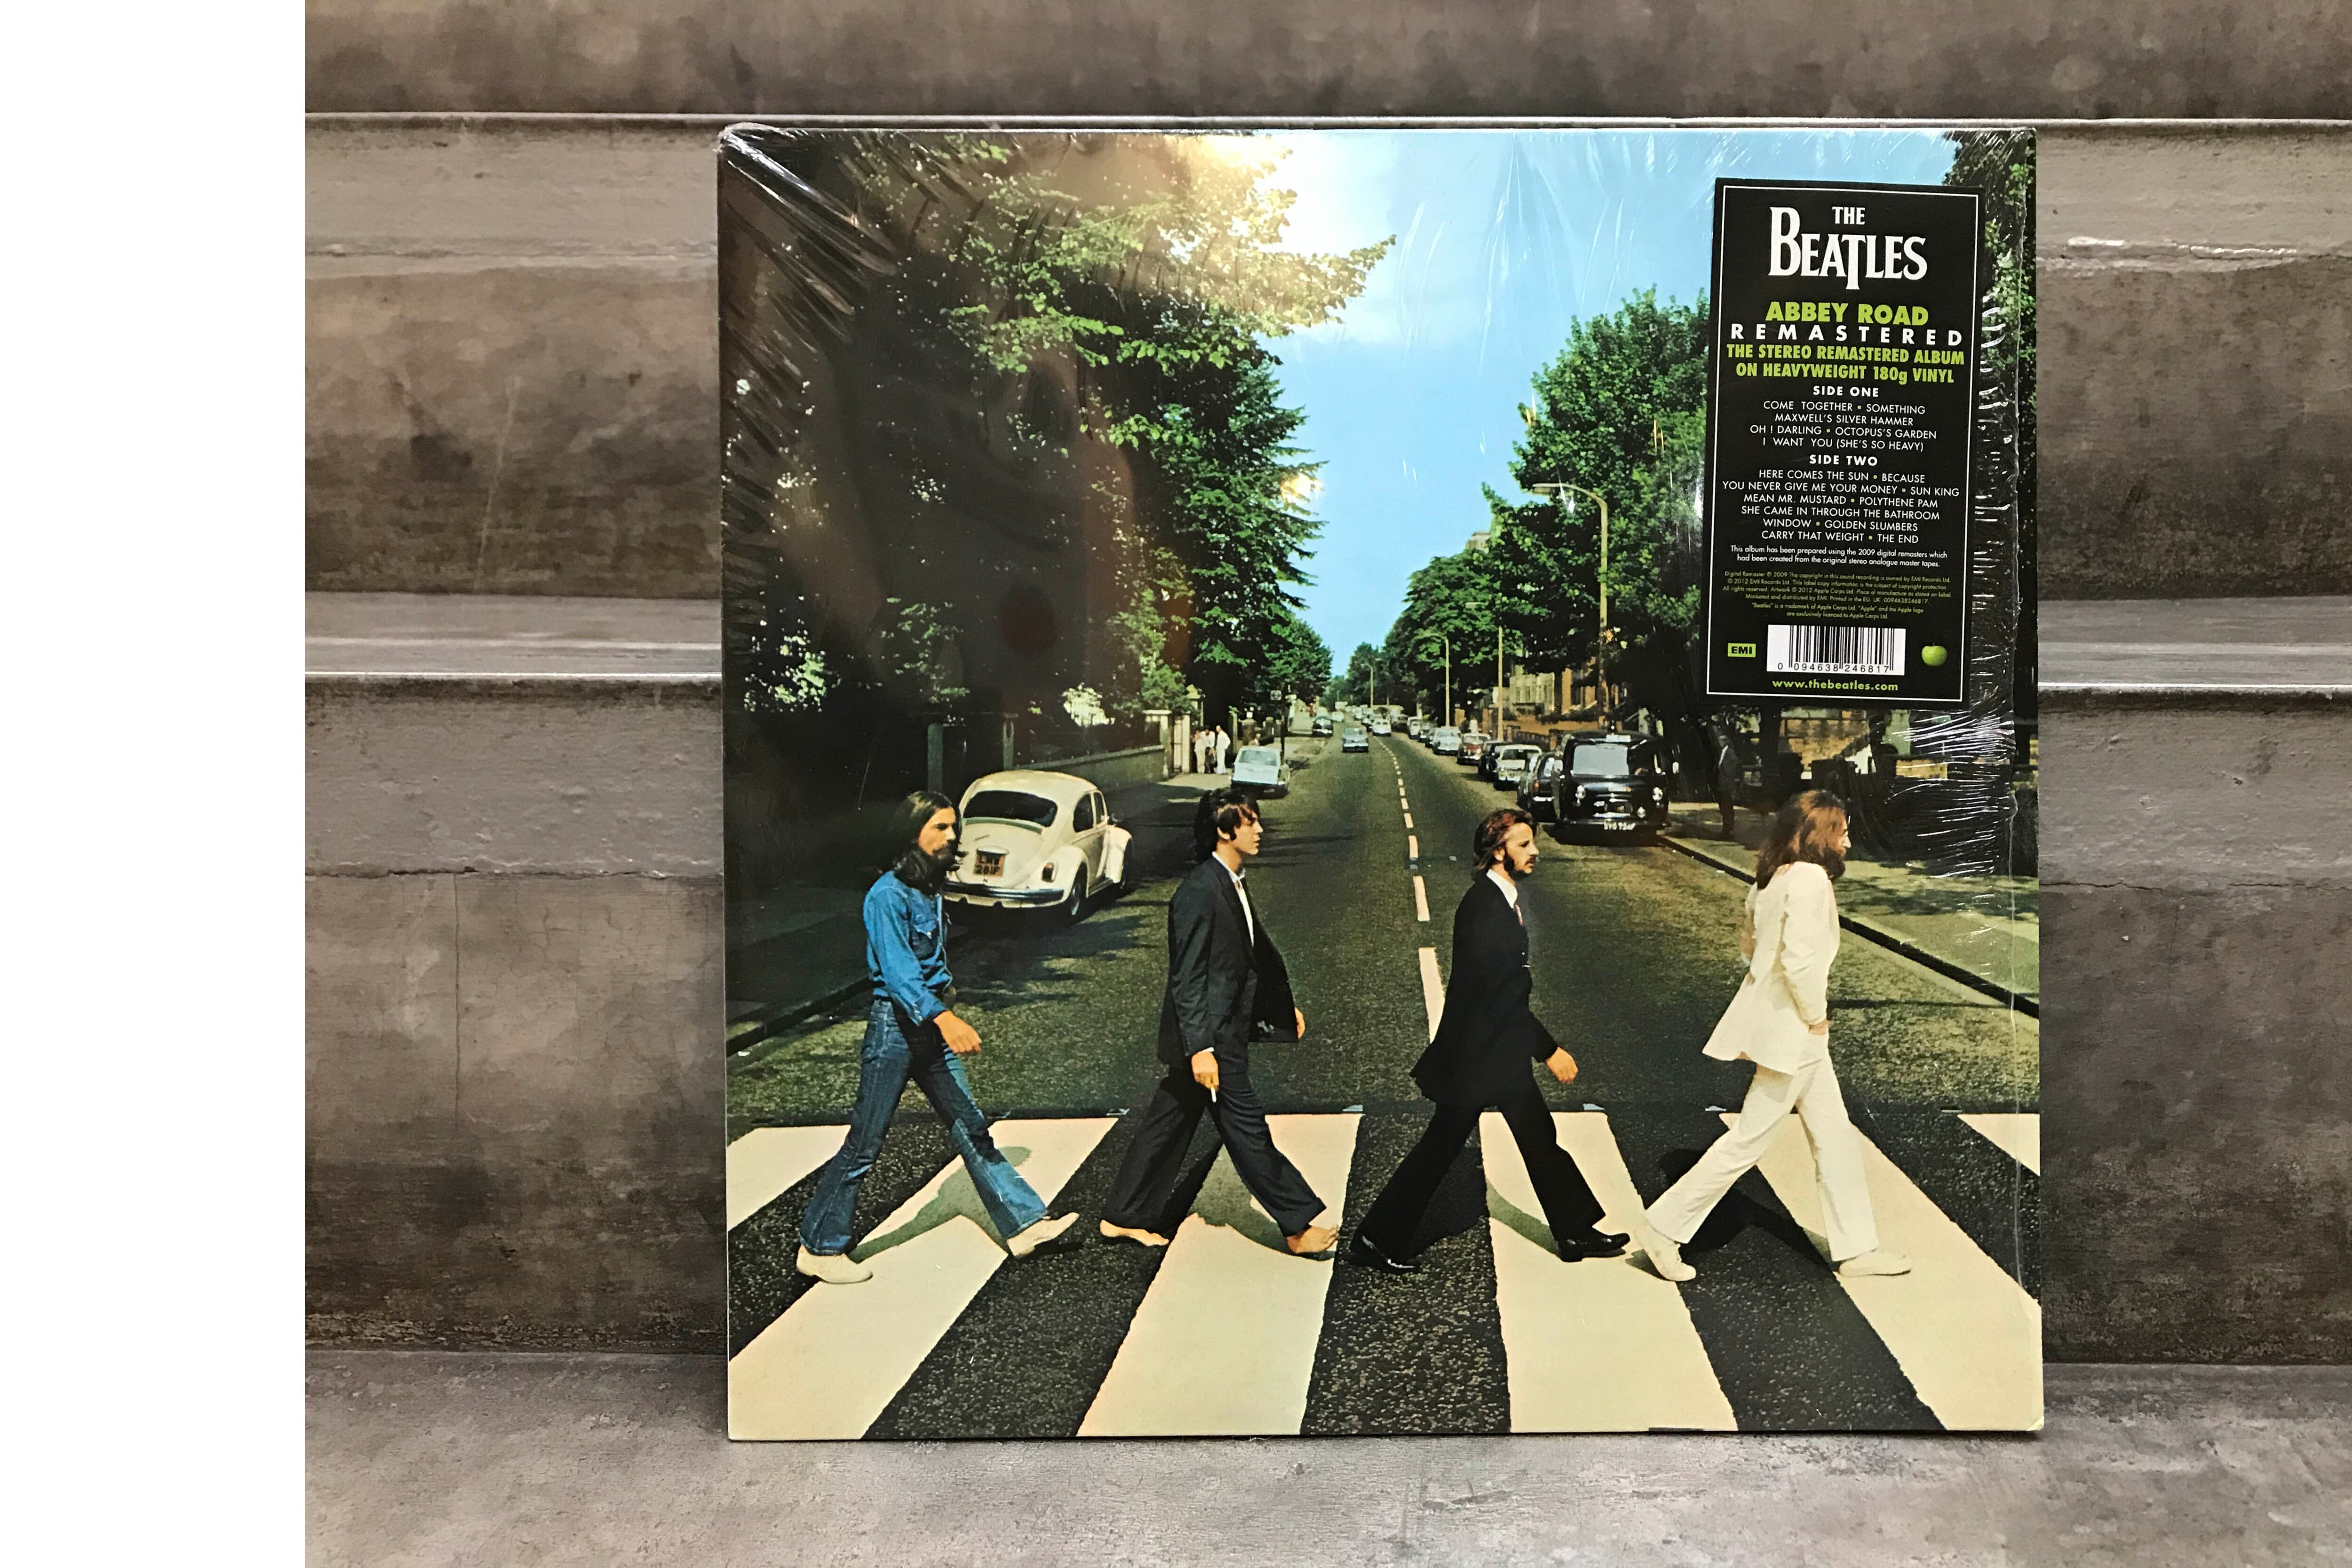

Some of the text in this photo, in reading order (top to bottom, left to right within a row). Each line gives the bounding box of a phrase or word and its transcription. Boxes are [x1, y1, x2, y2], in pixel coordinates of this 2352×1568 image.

[1832, 206, 1866, 225] THE
[1768, 207, 1927, 290] BEATLES
[1765, 301, 1929, 326] ABBEY ROAD
[1726, 344, 1964, 365] THE STEREO REMASTERED ALBUM
[1736, 362, 1954, 385] ON HEAVYWEIGHT 180g VINYL
[1813, 385, 1879, 397] SIDE ONE
[1764, 400, 1925, 414] COME TOGETHER SOMETHING
[1836, 414, 1867, 424] SILVER
[1870, 416, 1913, 426] HAMMER
[1777, 425, 1822, 435] DARLING
[1895, 429, 1937, 439] GARDEN
[1763, 437, 1765, 446] I
[1772, 437, 1804, 446] WANT
[1811, 438, 1833, 447] YOU
[1871, 440, 1885, 449] SO
[1889, 441, 1923, 452] HEAVY)
[1809, 454, 1878, 466] SIDE TWO
[1759, 469, 1925, 483] HERE COMES THE SUN BECAUSE
[1723, 481, 1959, 497] YOU NEVER GIVE ME YOUR MONEY SUN KING
[1744, 493, 1938, 508] MEAN MR. MUSTARD POLYTHENE PAM
[1741, 505, 1939, 520] SHE CAME IN THROUGH THE BATHROOM
[1763, 518, 1918, 532] WINDOW GOLDEN SLUMBERS
[1762, 530, 1919, 543] CARRY THAT WEIGHT THE END
[1797, 547, 1827, 556] prepared
[1876, 549, 1897, 558] digital
[1822, 557, 1847, 565] original
[1868, 557, 1898, 567] analogue
[1731, 646, 1752, 654] EMI
[1772, 678, 1898, 691] www.thebeatles.com
